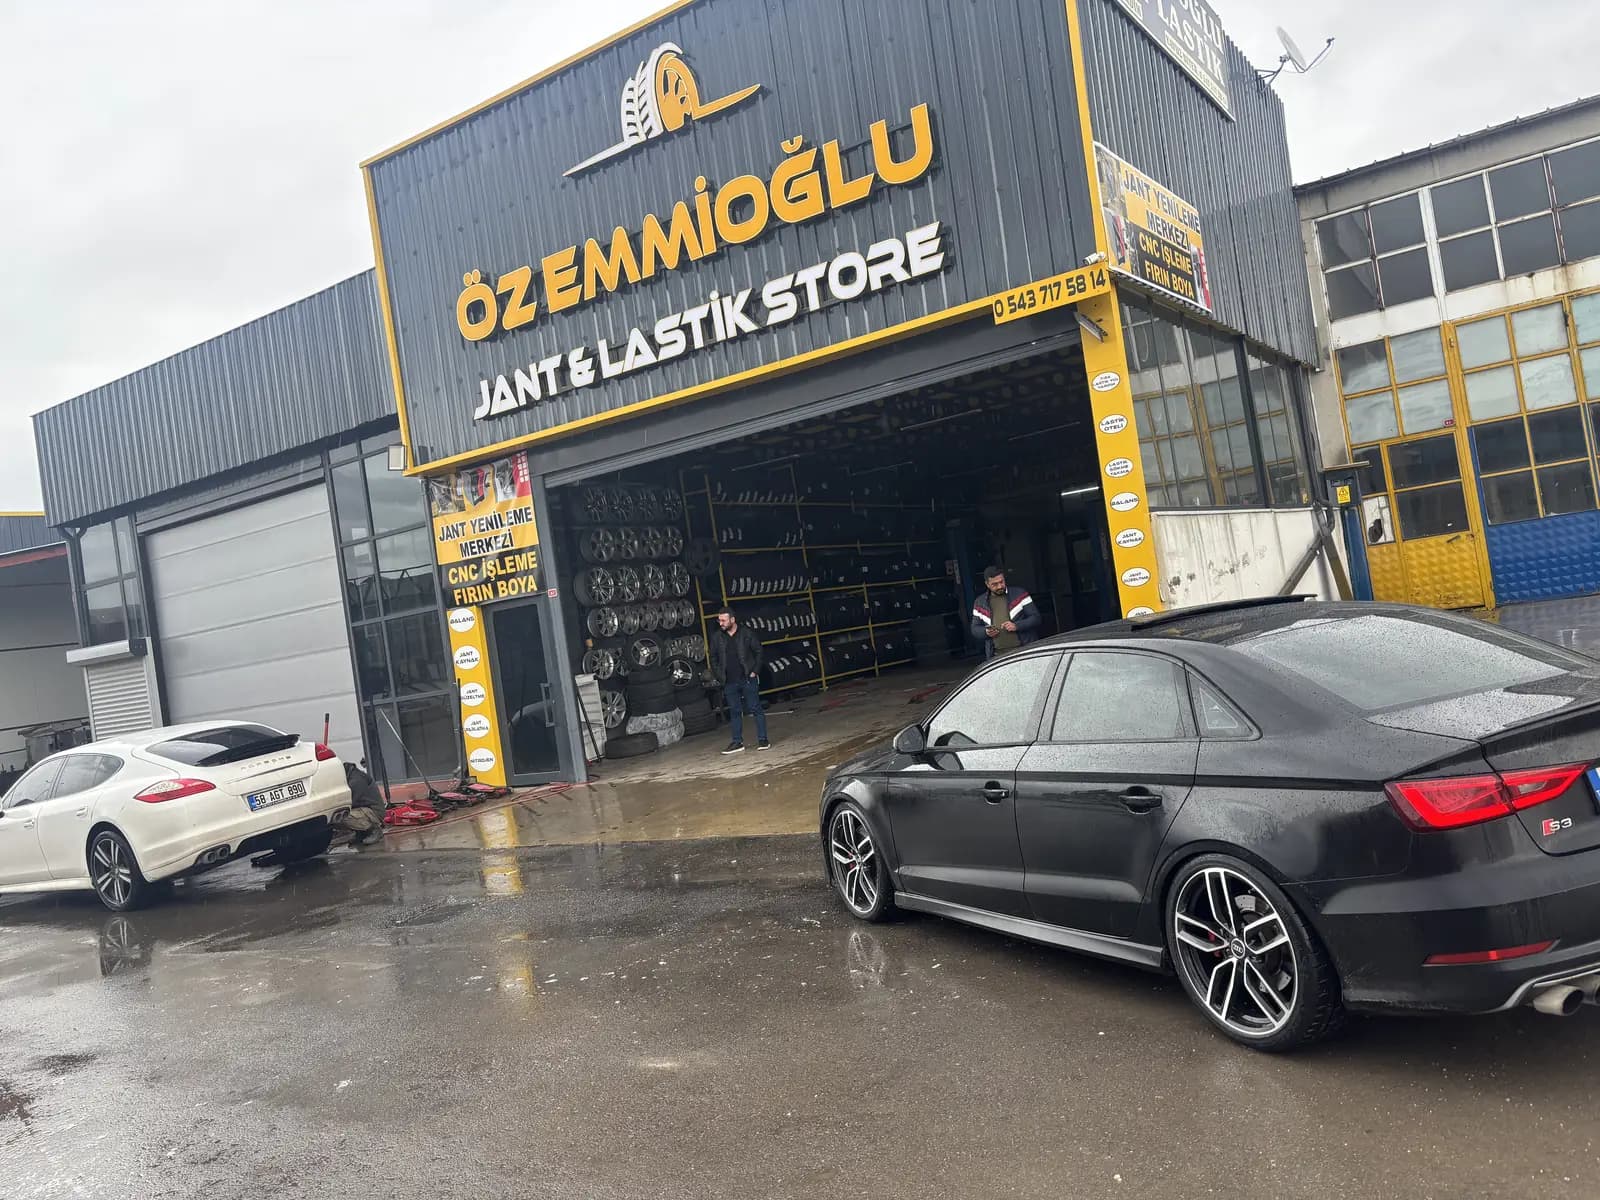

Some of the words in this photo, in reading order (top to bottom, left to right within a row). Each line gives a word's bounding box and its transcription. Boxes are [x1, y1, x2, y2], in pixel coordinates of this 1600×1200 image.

[1123, 170, 1152, 203] JANT
[456, 103, 935, 341] ÖZEMMİOĞLU
[1139, 231, 1160, 258] CNC
[1160, 242, 1193, 276] İŞLEME
[1007, 290, 1036, 314] 543
[1040, 281, 1062, 304] 717
[1066, 274, 1087, 297] 58
[1089, 269, 1106, 290] 14
[1145, 260, 1170, 288] FIRIN
[1171, 273, 1195, 299] BOYA
[474, 354, 562, 419] JANT
[598, 290, 759, 379] LASTİK
[761, 221, 944, 327] STORE
[1111, 497, 1138, 506] BALANS
[439, 522, 466, 542] JANT
[470, 506, 533, 533] YENİLEME
[459, 529, 514, 558] MERKEZİ
[448, 563, 479, 585] CNC
[482, 551, 538, 582] İŞLEME
[453, 584, 494, 606] FIRIN
[497, 575, 538, 599] BOYA
[450, 615, 475, 625] BALANS
[455, 656, 480, 665] KAYNAK
[459, 650, 474, 658] JANT
[269, 788, 285, 802] AGT
[287, 783, 303, 796] 890
[1550, 817, 1573, 831] S3
